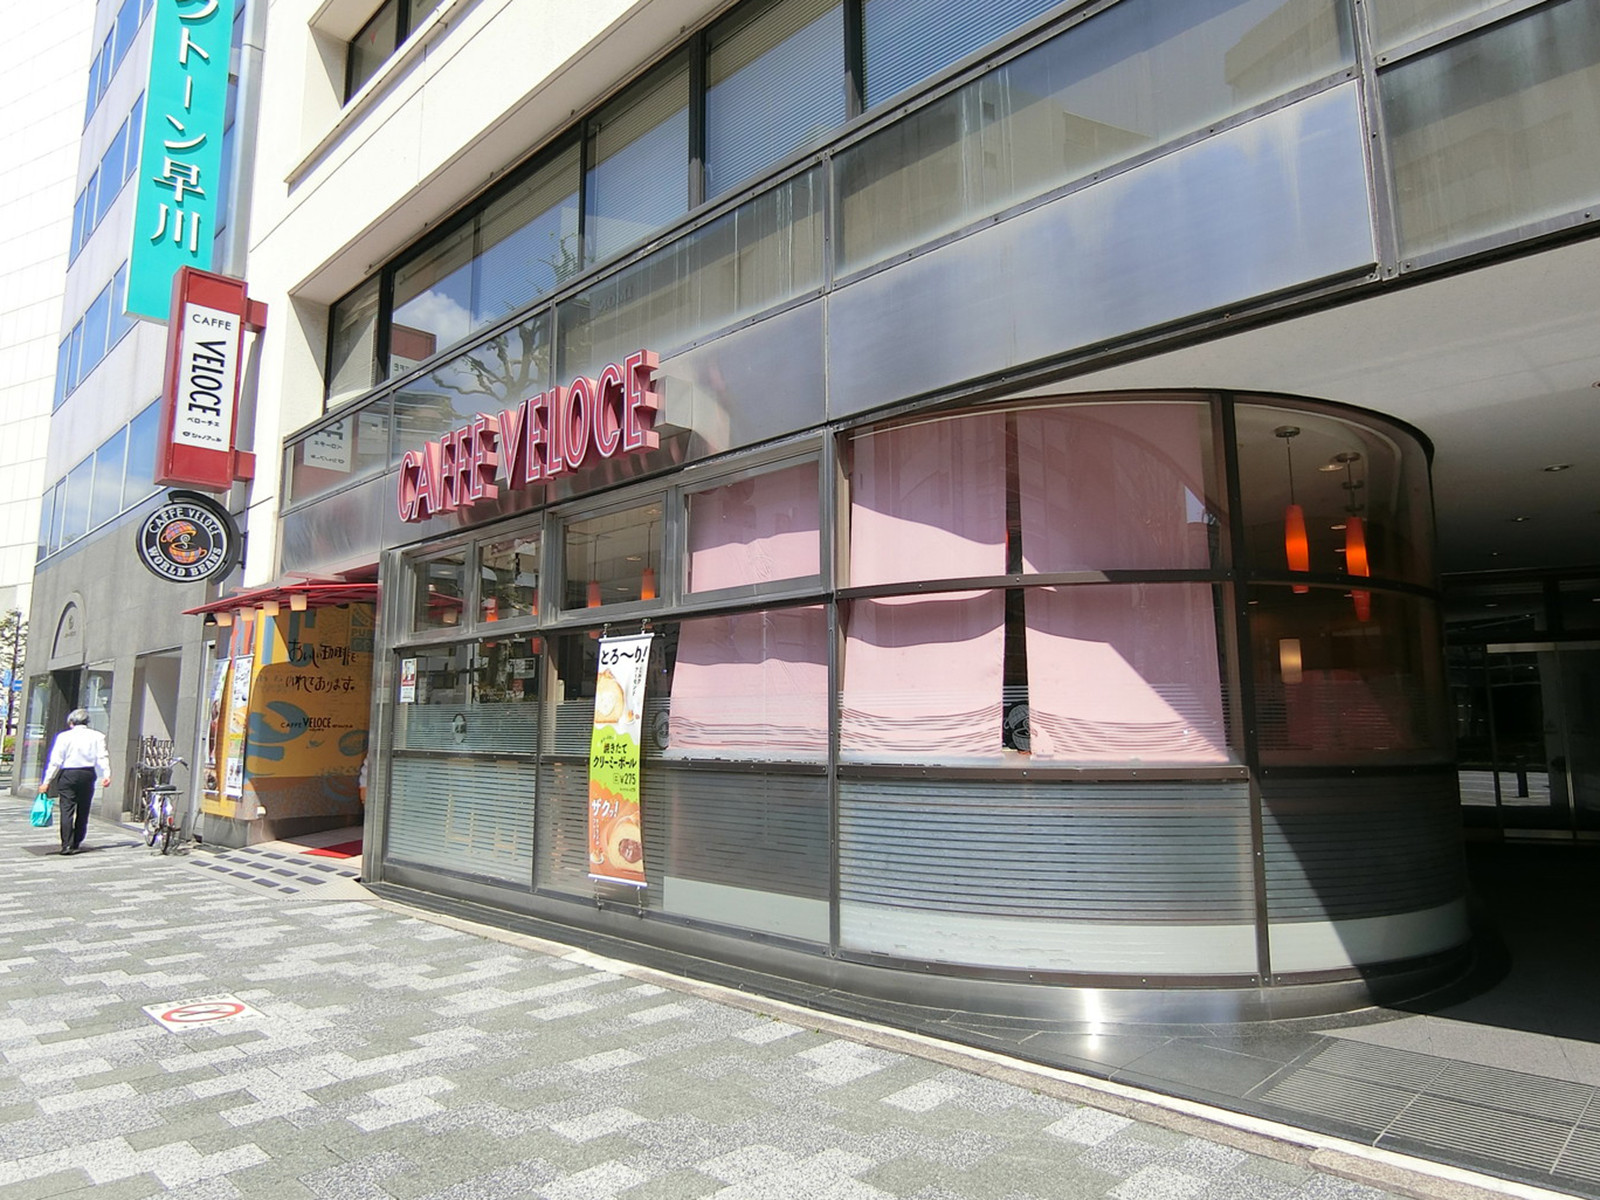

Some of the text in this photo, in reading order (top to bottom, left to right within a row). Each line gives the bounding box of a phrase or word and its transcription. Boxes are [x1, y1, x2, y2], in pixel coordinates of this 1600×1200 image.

[188, 340, 227, 417] VELOCE
[497, 349, 660, 490] VELOCE
[149, 508, 221, 535] CAFFE VELOCE
[148, 545, 222, 577] WORLD BEANS
[302, 716, 332, 729] VELOCE
